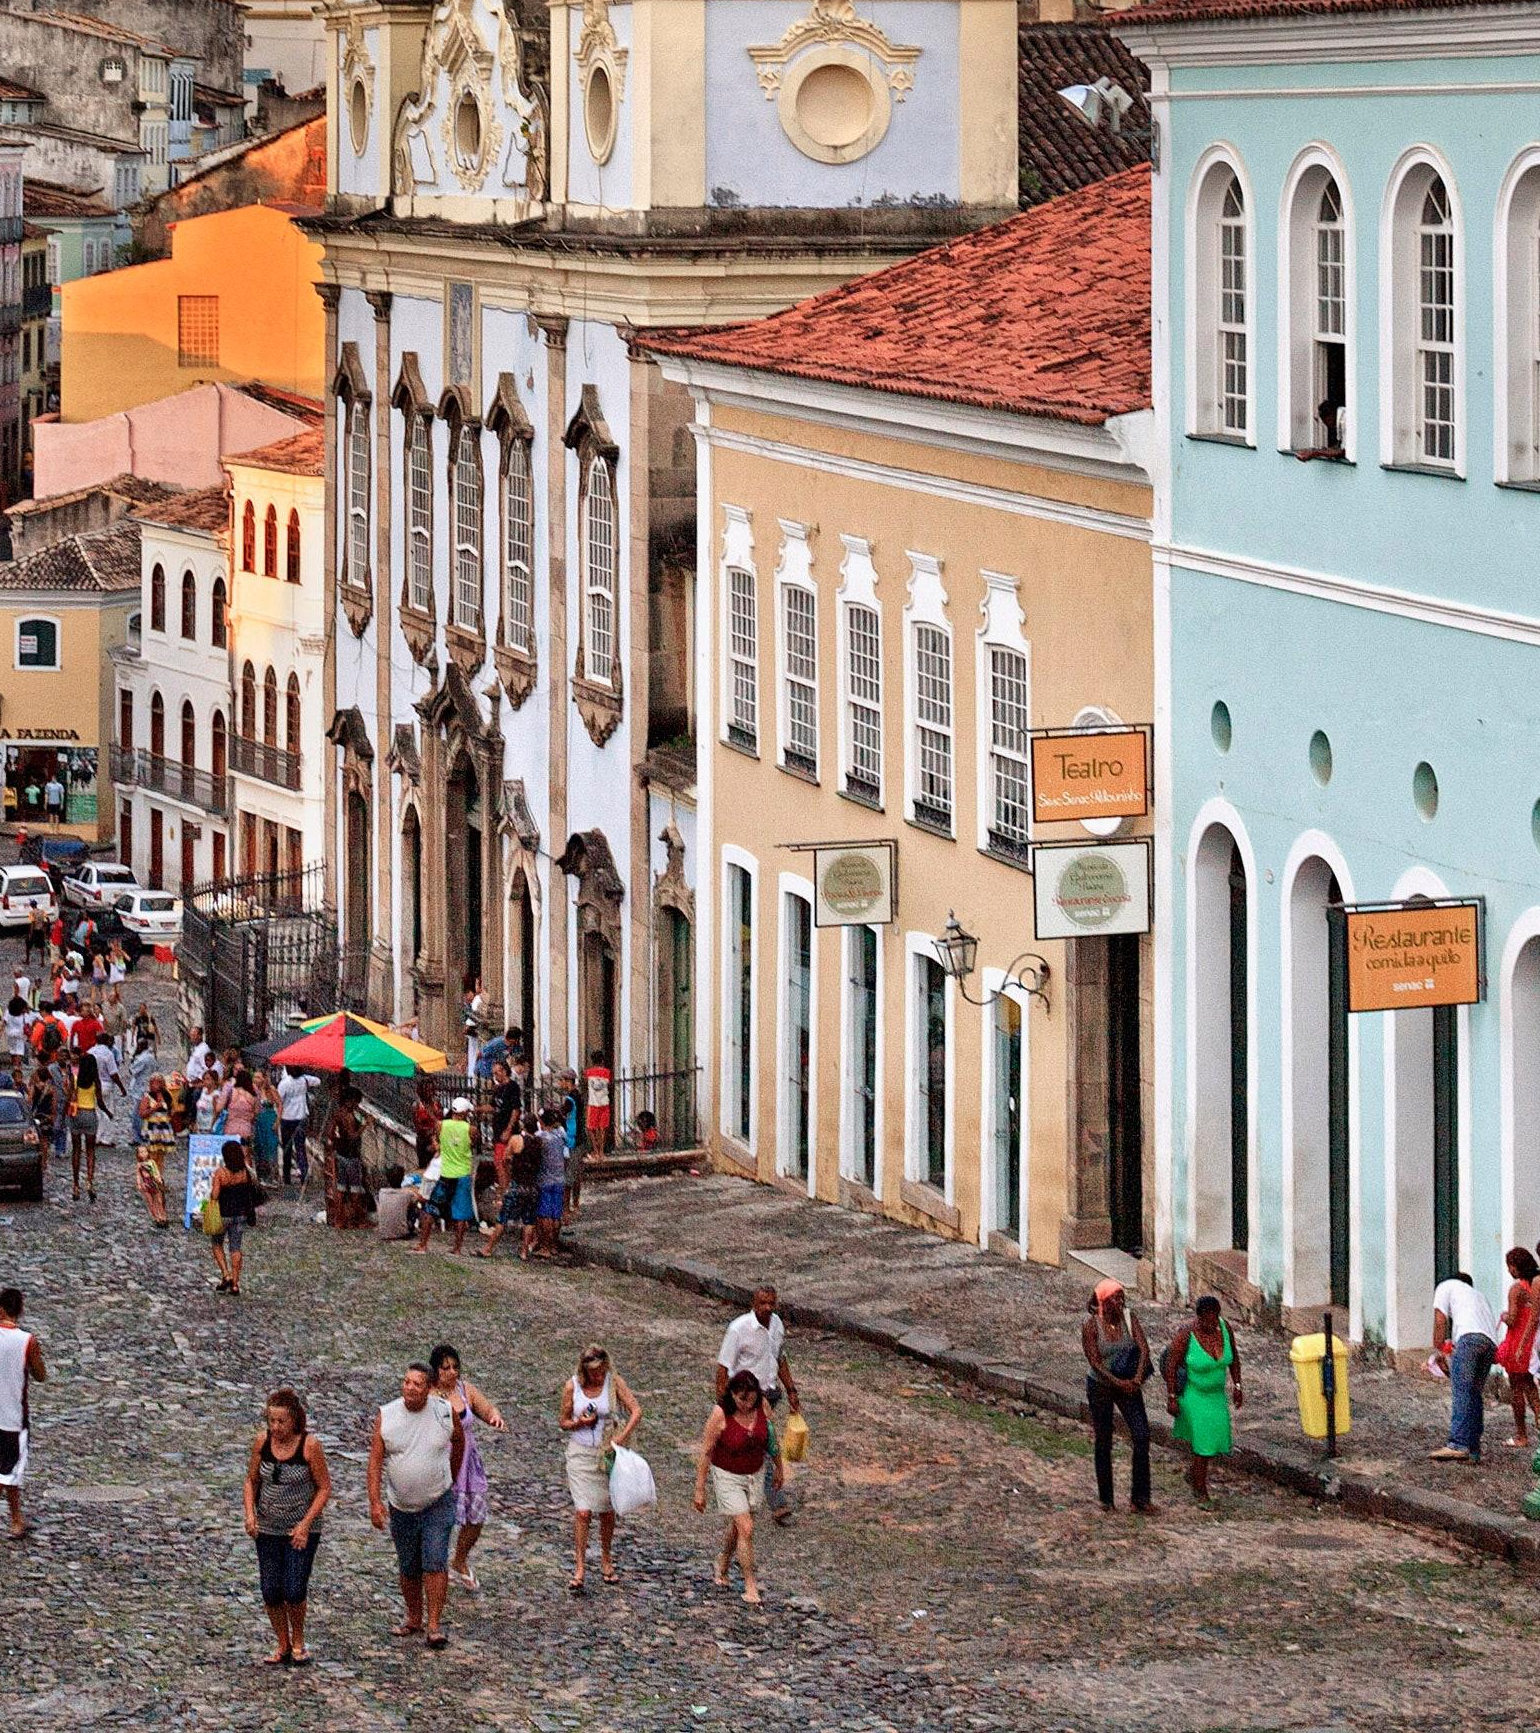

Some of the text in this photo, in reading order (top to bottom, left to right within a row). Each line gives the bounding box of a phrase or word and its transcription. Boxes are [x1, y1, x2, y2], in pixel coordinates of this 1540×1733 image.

[17, 728, 80, 740] FAZENDA
[1053, 753, 1124, 781] Teatro
[1352, 925, 1472, 951] Restaurante
[1392, 979, 1423, 992] senac
